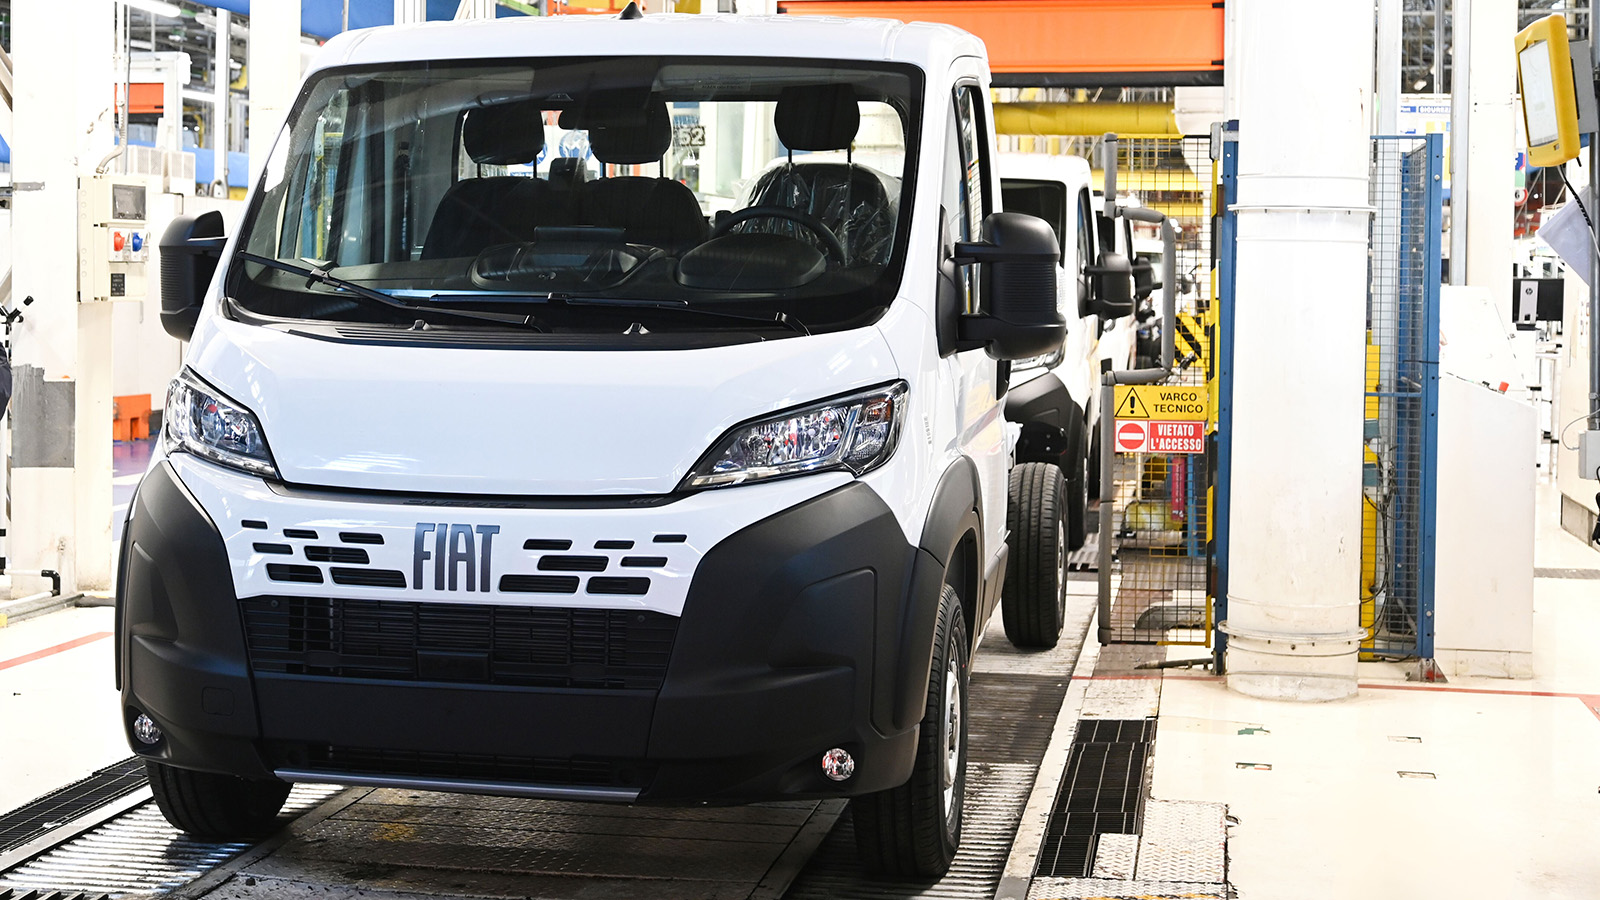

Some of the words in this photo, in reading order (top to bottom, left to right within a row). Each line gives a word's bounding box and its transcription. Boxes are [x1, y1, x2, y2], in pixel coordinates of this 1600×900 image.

[1159, 392, 1198, 402] VARCO
[1153, 404, 1203, 413] TECNICO
[1157, 424, 1194, 436] VIETATO
[1150, 438, 1202, 450] L'ACCESSO
[412, 522, 501, 593] FIAT
